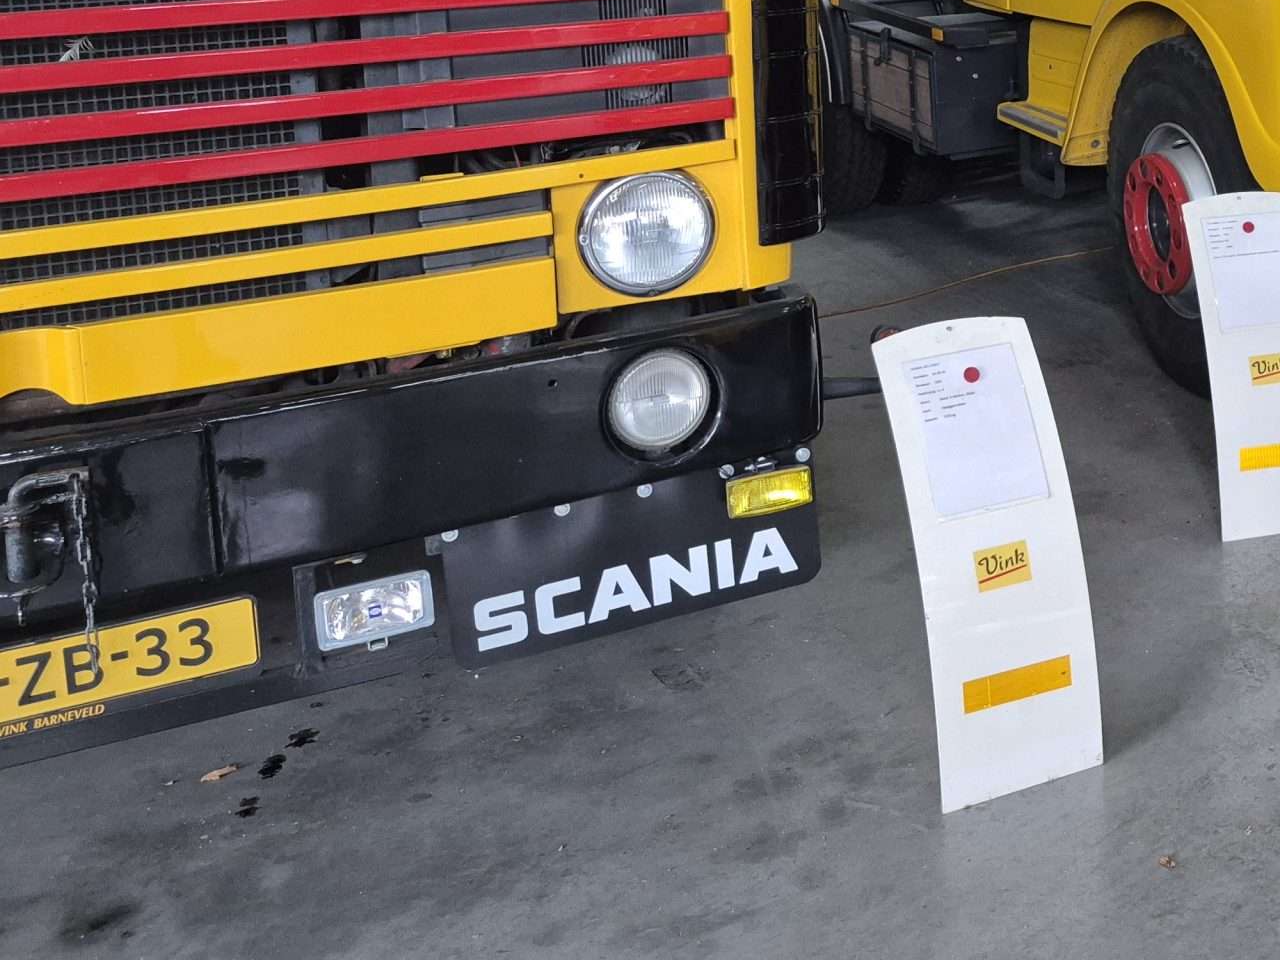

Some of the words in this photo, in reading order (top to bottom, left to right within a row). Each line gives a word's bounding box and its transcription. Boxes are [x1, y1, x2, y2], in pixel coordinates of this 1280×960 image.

[977, 548, 1025, 575] Vink
[473, 527, 799, 652] SCANIA
[33, 704, 105, 729] BARNEVELD
